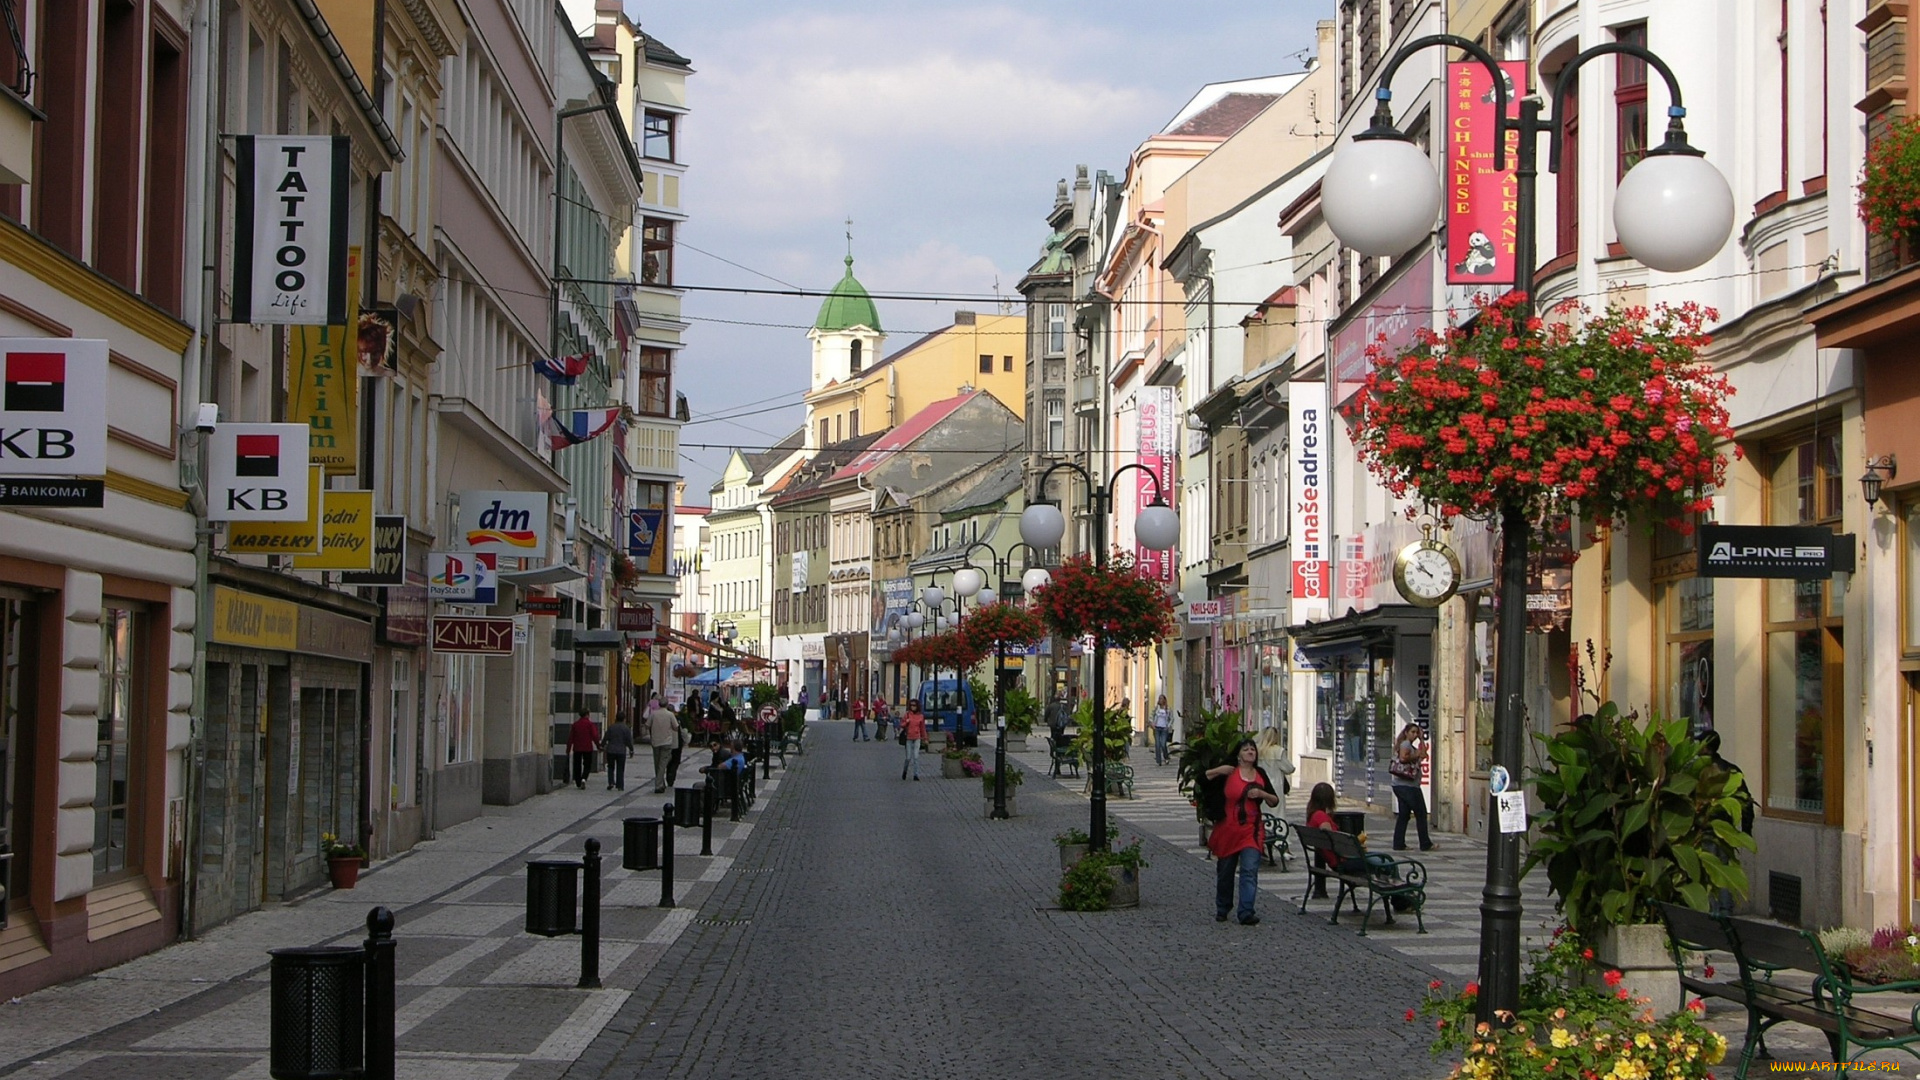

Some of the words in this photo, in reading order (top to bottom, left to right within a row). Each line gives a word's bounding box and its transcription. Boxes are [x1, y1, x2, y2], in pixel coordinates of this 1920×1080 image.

[1454, 116, 1472, 214] CHINESE
[1470, 151, 1495, 159] shan
[1502, 116, 1519, 254] ESTAURANT
[275, 146, 308, 292] TATTOO
[271, 293, 307, 316] Life
[308, 325, 335, 448] lárium
[1141, 403, 1157, 453] PLUS
[0, 428, 75, 459] KB
[1297, 408, 1319, 543] našeadresa
[11, 486, 88, 497] BANKOMAT
[226, 488, 288, 511] KB
[323, 509, 361, 524] ódní
[478, 500, 530, 530] dm
[1140, 457, 1157, 580] PRENT
[232, 535, 315, 548] KABELKY
[322, 532, 366, 551] plňky
[1708, 542, 1793, 560] ALPINE
[430, 586, 471, 596] PlayStato
[435, 621, 511, 649] KNIHY
[1414, 678, 1431, 786] naadresa
